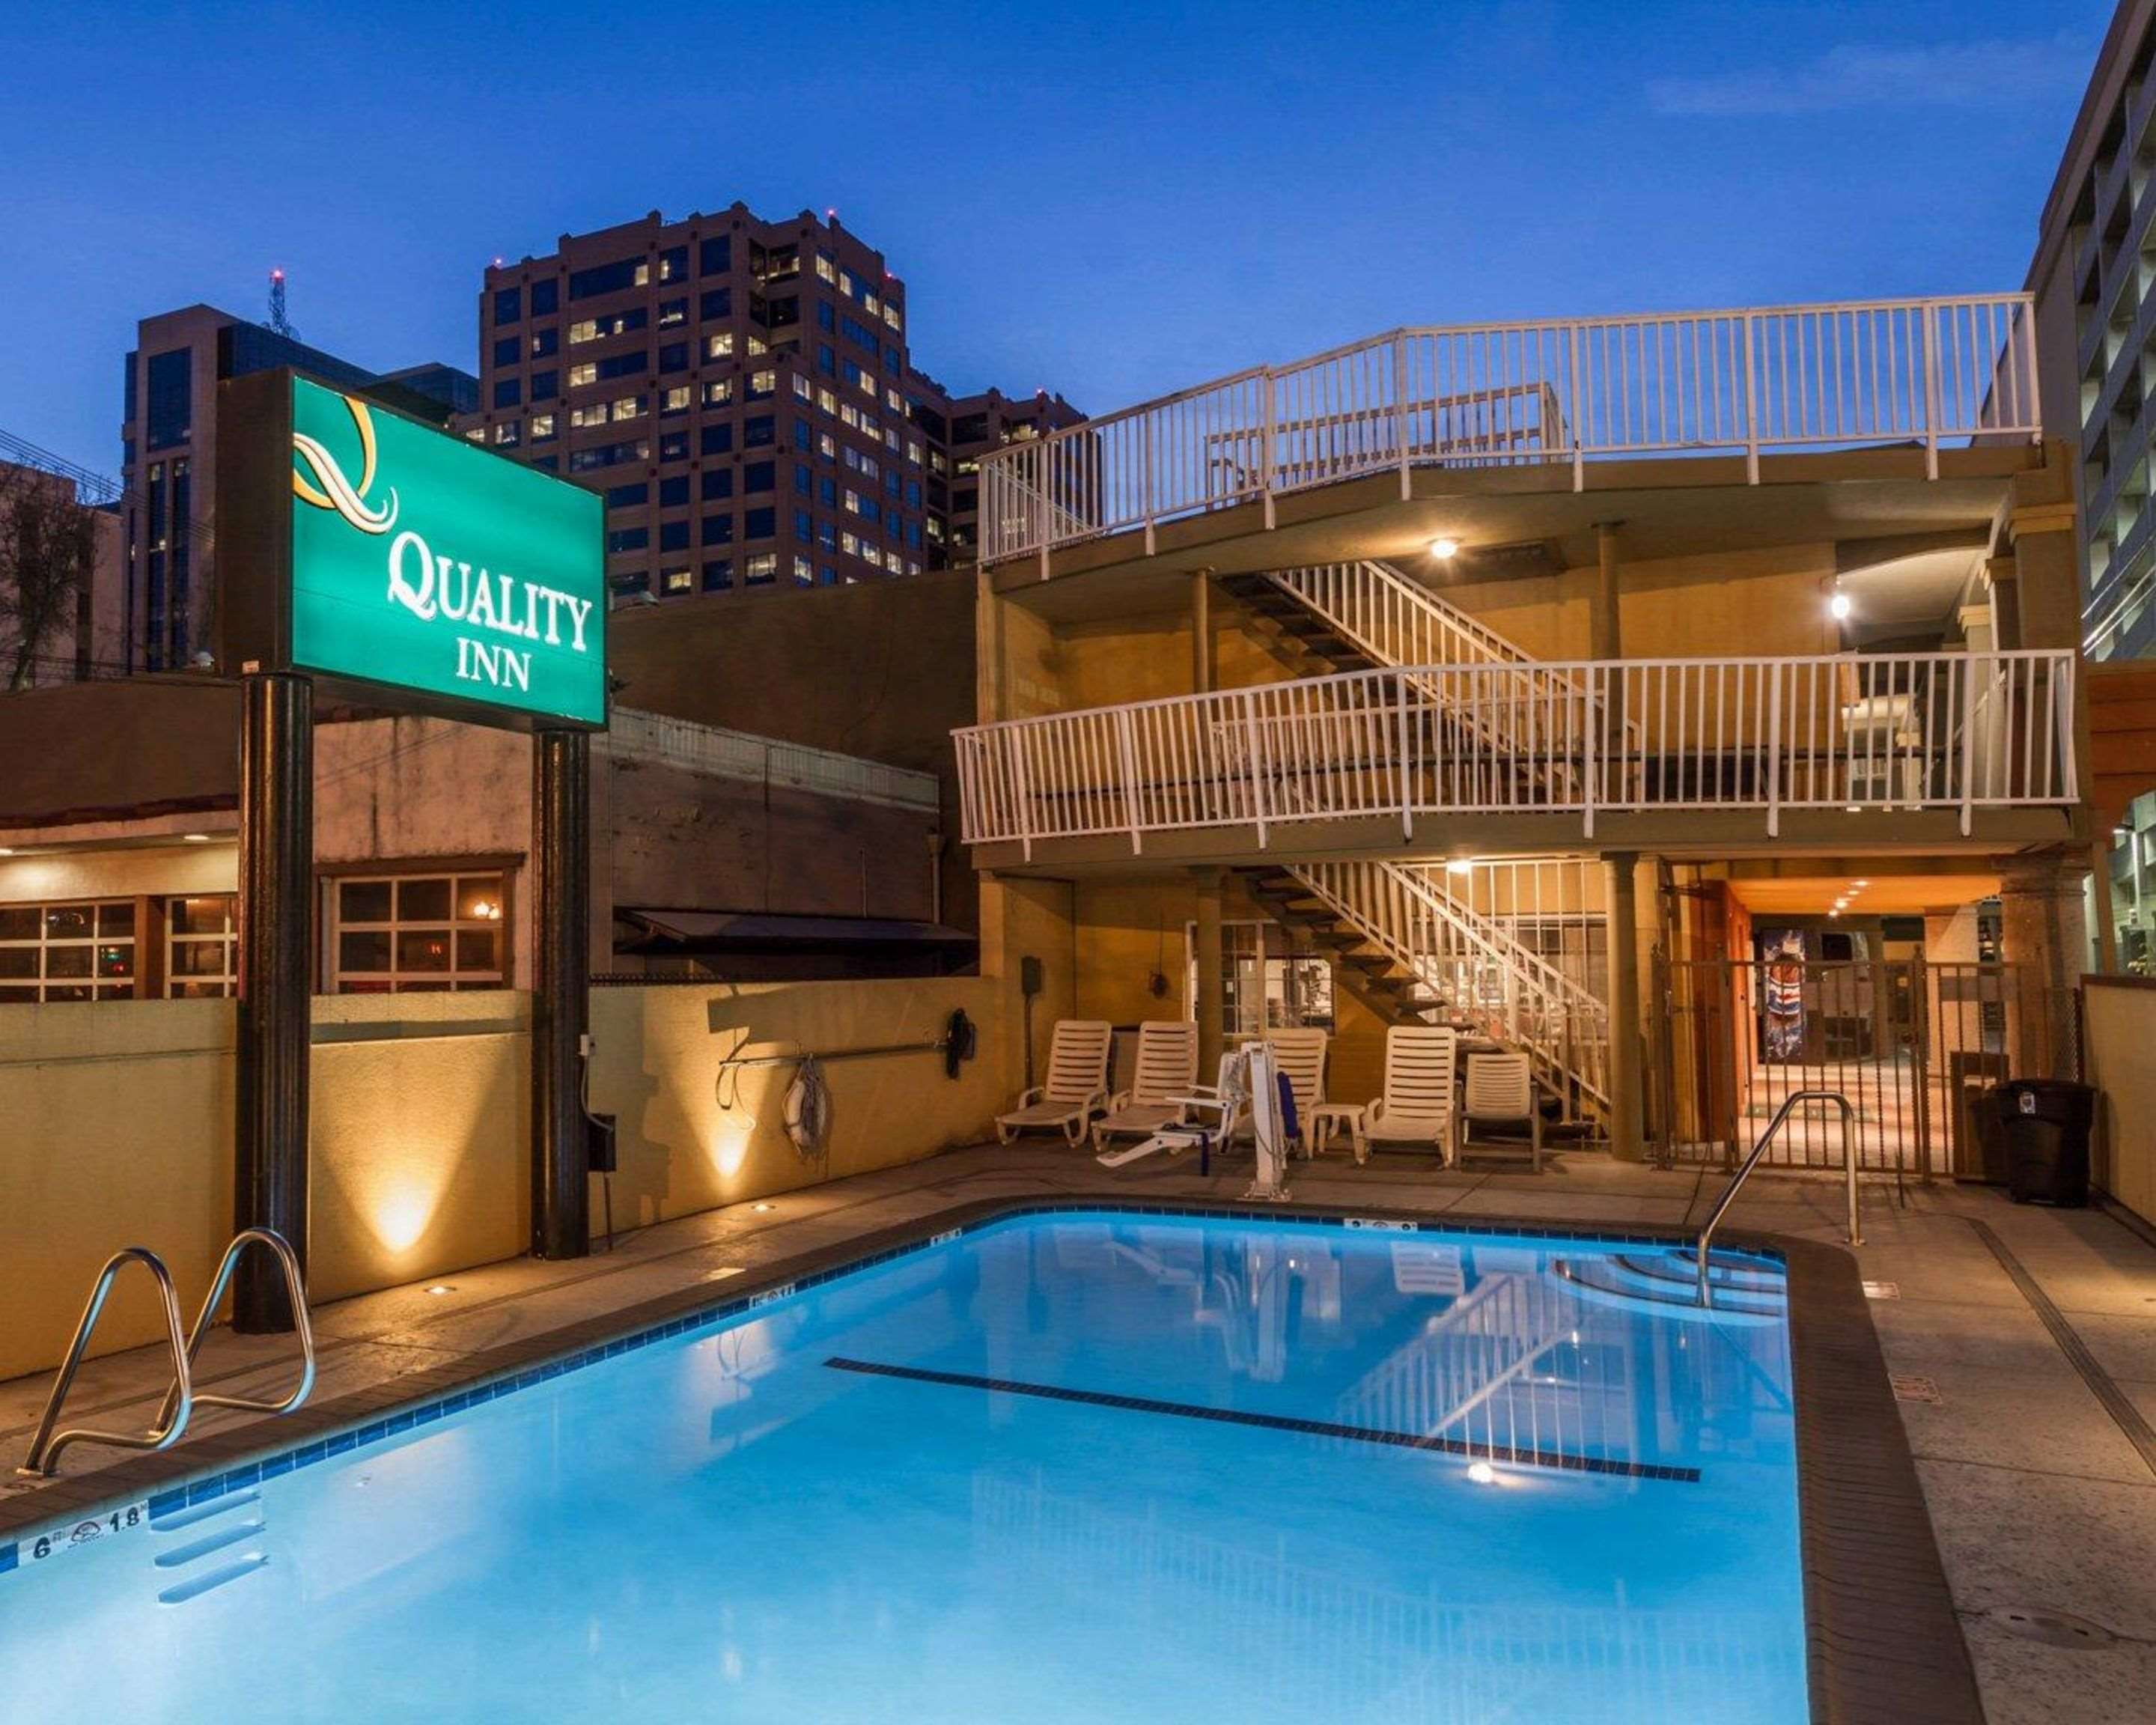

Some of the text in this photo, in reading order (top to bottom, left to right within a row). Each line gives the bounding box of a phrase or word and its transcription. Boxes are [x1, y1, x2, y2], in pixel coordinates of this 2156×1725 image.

[387, 531, 593, 651] QUALITY
[455, 636, 533, 693] INN
[32, 1536, 52, 1560] 6
